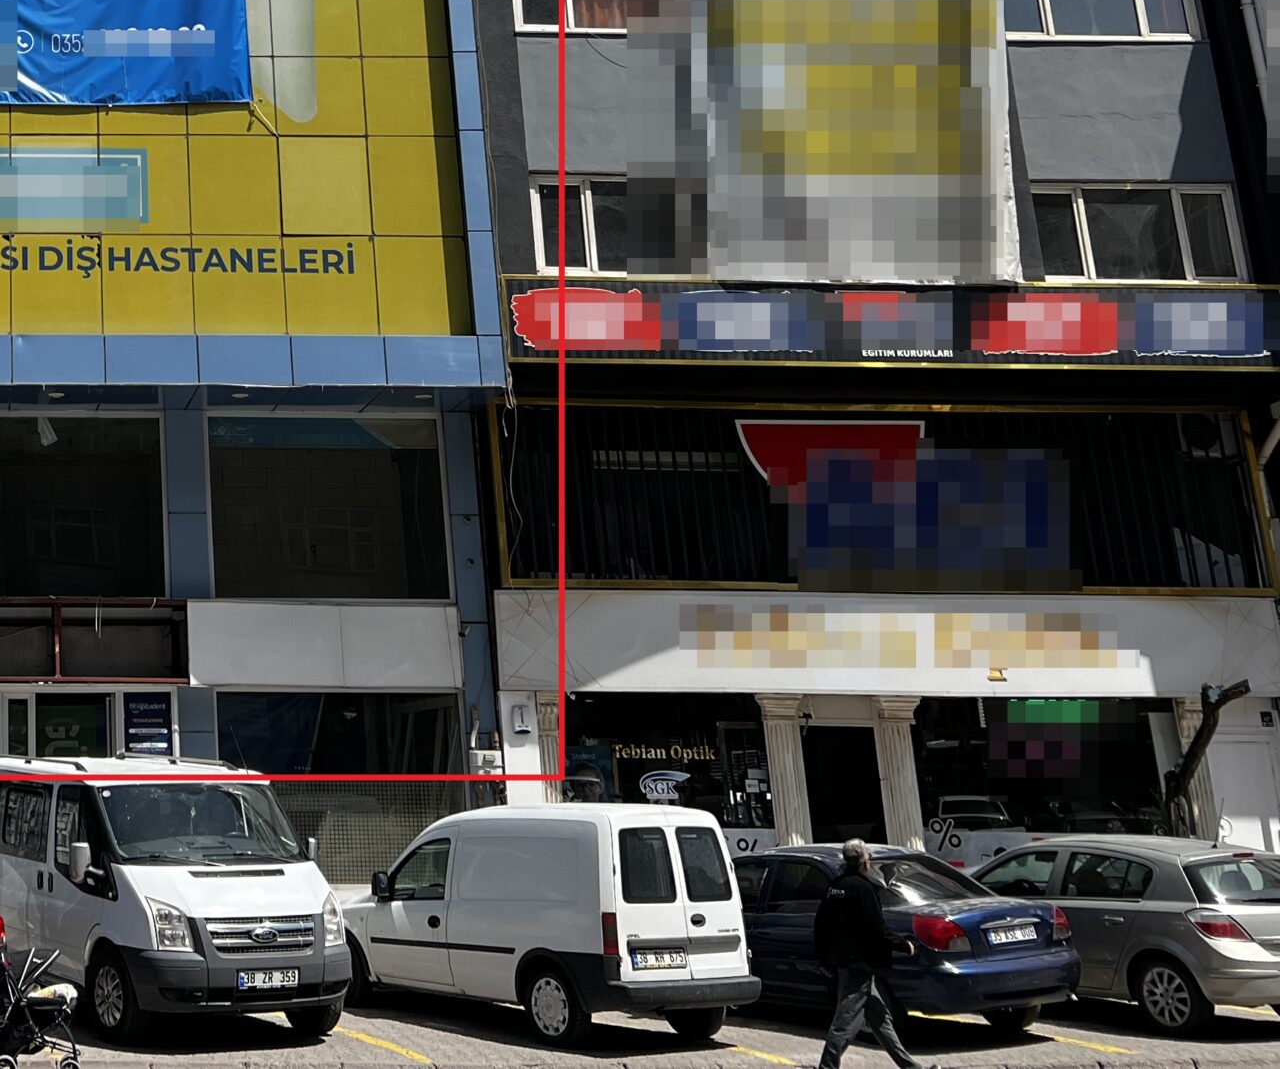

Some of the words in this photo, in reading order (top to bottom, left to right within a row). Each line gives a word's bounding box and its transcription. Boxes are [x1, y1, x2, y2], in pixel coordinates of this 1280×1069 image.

[40, 239, 97, 279] DİŞ
[108, 242, 355, 275] HASTANELERİ
[897, 349, 953, 358] KURUMLARI
[670, 744, 716, 763] Optik
[646, 780, 677, 795] SGK
[244, 971, 256, 984] 38
[262, 971, 273, 984] ZR
[280, 970, 296, 983] 359
